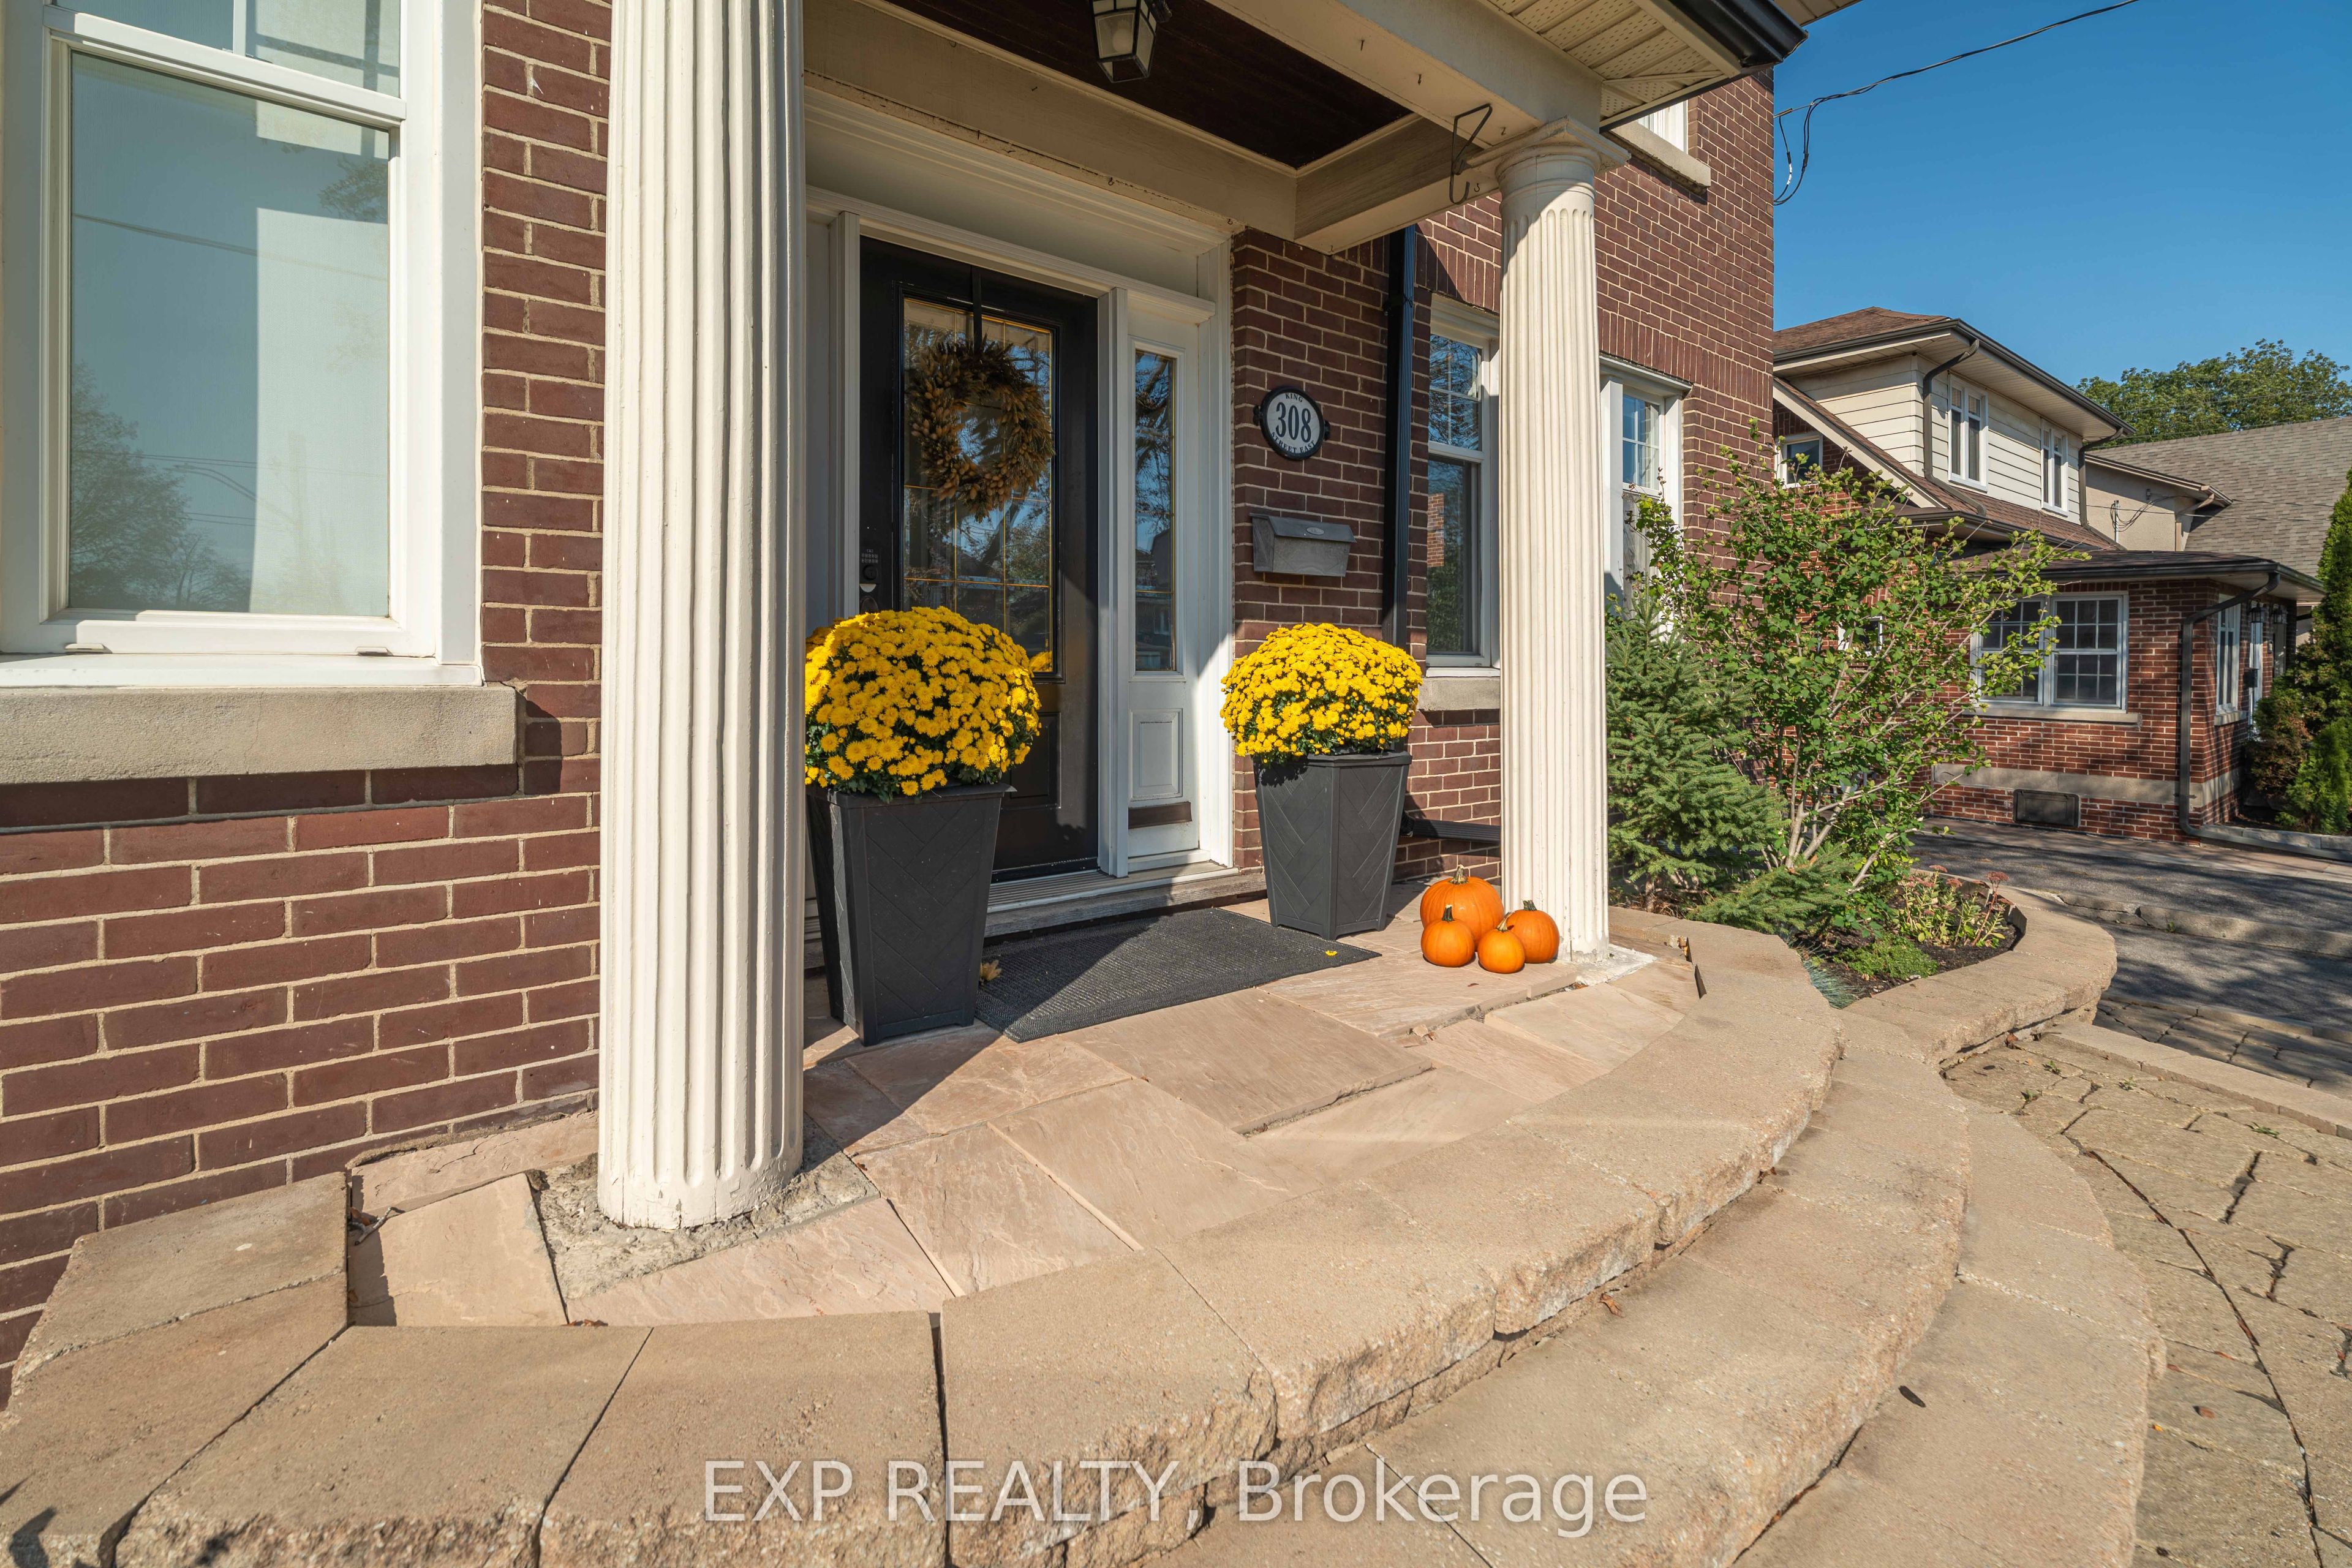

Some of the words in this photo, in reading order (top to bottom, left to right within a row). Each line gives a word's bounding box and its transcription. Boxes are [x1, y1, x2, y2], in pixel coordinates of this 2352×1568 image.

[1285, 393, 1303, 402] KING
[1275, 402, 1311, 443] 308
[1272, 432, 1297, 453] STREET
[1300, 440, 1316, 453] EAST
